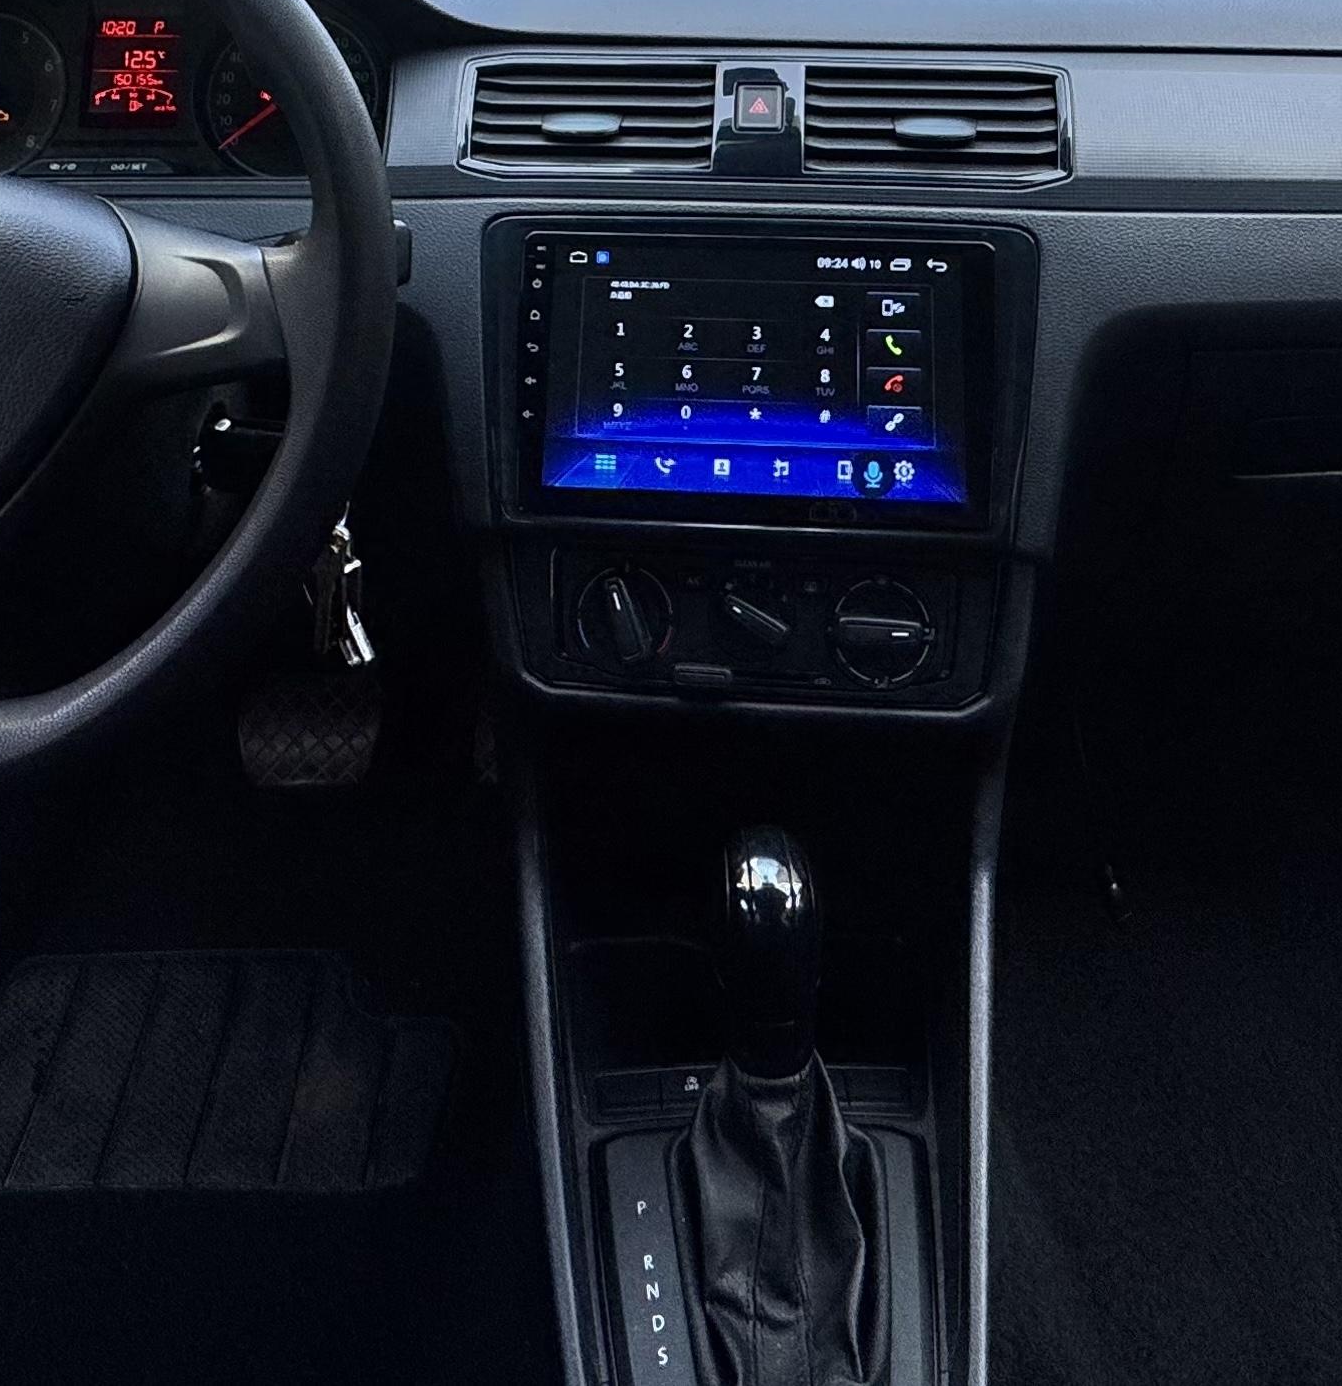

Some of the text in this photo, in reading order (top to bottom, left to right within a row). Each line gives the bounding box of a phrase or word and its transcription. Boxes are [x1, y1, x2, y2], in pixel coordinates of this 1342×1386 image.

[101, 20, 165, 35] 10:20 P
[21, 31, 30, 44] 5
[44, 59, 54, 72] 6
[25, 135, 35, 148] 8
[817, 256, 848, 269] 09:24
[869, 259, 881, 270] 10
[615, 322, 625, 337] 1
[683, 323, 693, 338] 2
[752, 325, 762, 340] 3
[819, 328, 831, 342] 4
[677, 341, 699, 352] ABC
[746, 343, 767, 353] DEF
[816, 345, 835, 355] GHI
[614, 362, 625, 377] 5
[682, 364, 692, 379] 6
[751, 366, 762, 381] 7
[820, 368, 831, 383] 8
[815, 386, 836, 397] TUV
[612, 402, 623, 418] 9
[680, 404, 692, 419] 0
[637, 1200, 647, 1216] P
[643, 1254, 654, 1270] R
[646, 1281, 660, 1300] N
[652, 1314, 665, 1332] D
[657, 1346, 669, 1367] S
